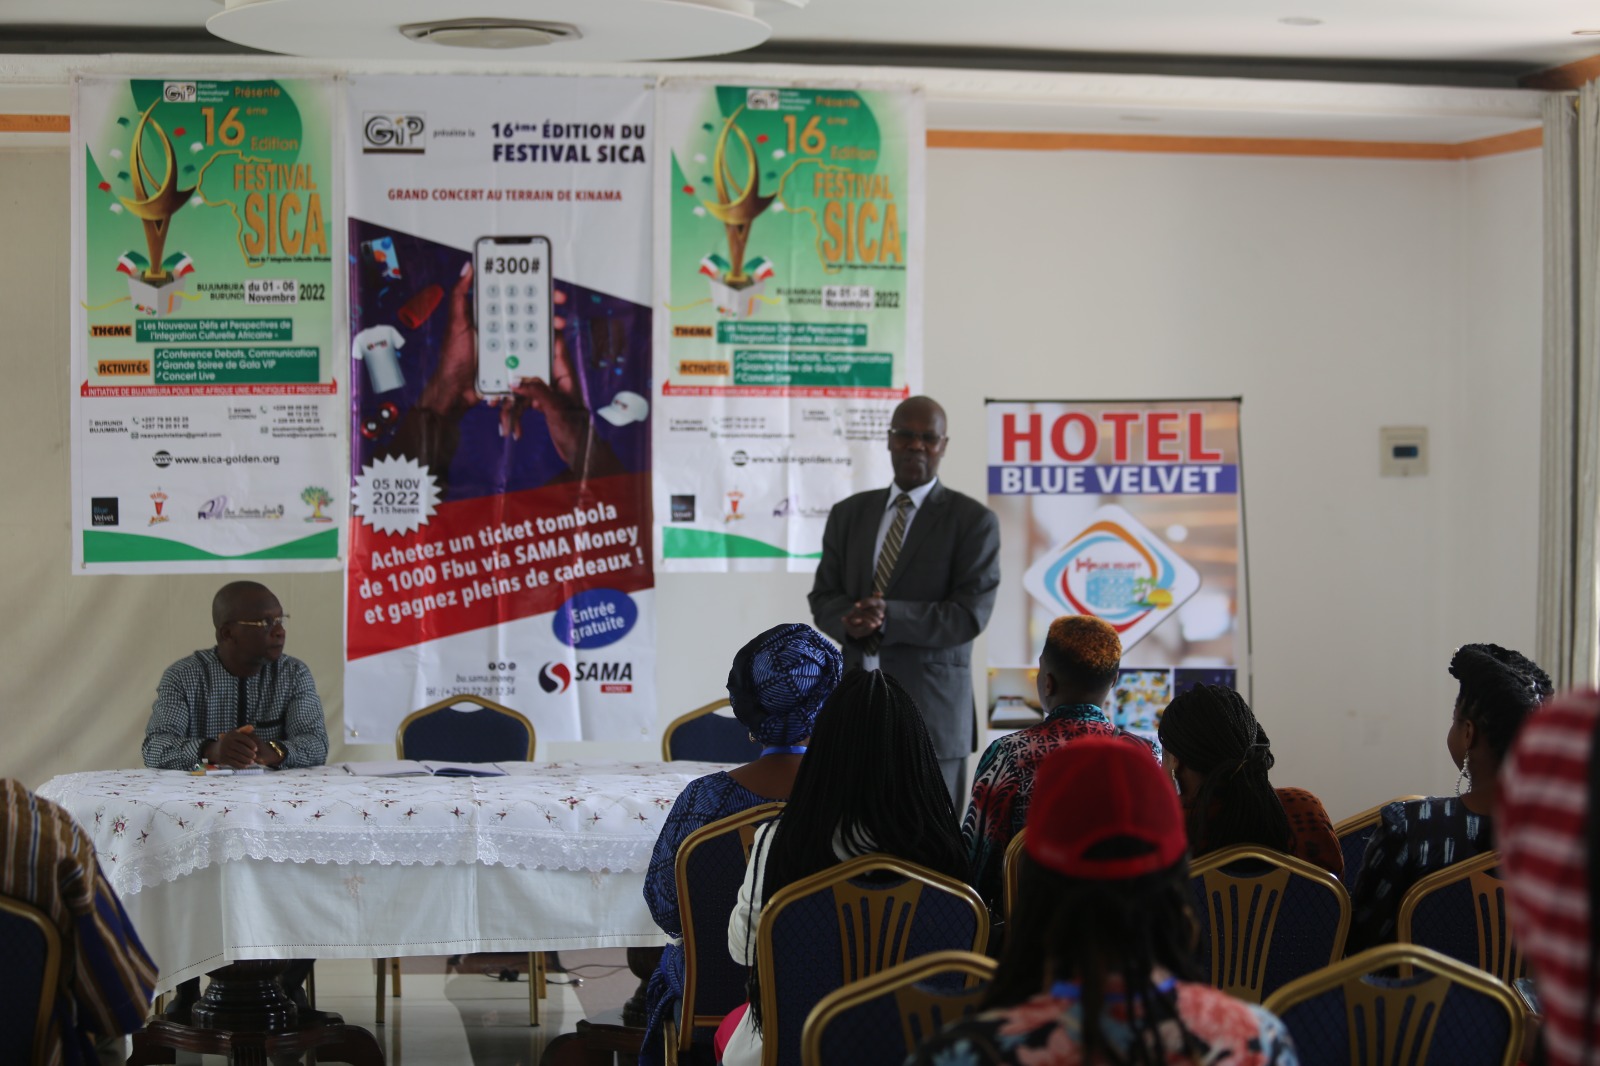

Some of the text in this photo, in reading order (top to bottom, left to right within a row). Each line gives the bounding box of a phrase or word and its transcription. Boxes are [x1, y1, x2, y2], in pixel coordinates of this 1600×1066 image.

[234, 86, 280, 98] Présente
[202, 106, 245, 147] 16
[543, 119, 614, 139] ÉDITION
[621, 124, 646, 139] DU
[783, 114, 827, 155] 16
[493, 144, 646, 163] FESTIVAL SICA
[234, 163, 317, 191] FESTIVAL
[814, 172, 894, 200] FESTIVAL
[388, 189, 623, 202] GRAND CONCERT AU TERRAIN DE KINAMA
[244, 192, 328, 256] SICA
[823, 201, 903, 263] SICA
[485, 257, 540, 275] #300#
[248, 282, 260, 291] du
[262, 282, 273, 291] 01
[283, 282, 295, 291] 06
[300, 284, 325, 301] 2022
[248, 293, 296, 303] Novembre
[92, 326, 132, 337] THEME
[144, 321, 157, 330] Les
[158, 321, 198, 331] Nouveaux
[220, 321, 228, 330] et
[229, 320, 279, 332] Perspectives
[280, 321, 291, 330] de
[199, 331, 236, 340] Culturelle
[237, 331, 273, 340] Africaine
[162, 349, 213, 359] Conference
[248, 348, 317, 359] Communication
[99, 361, 149, 374] ACTIVITÉS
[162, 360, 196, 371] Grande
[225, 360, 237, 370] de
[239, 360, 261, 370] Gala
[262, 359, 277, 369] VIP
[162, 371, 216, 381] Concert Live
[88, 388, 120, 396] INITIATIVE
[121, 388, 130, 396] DE
[131, 387, 171, 396] BUJUMBURA
[1002, 412, 1221, 462] HOTEL
[175, 453, 280, 465] www.sica-golden.org
[372, 478, 420, 490] 05 NOV
[1000, 466, 1222, 493] BLUE VELVET
[372, 491, 420, 506] 2022
[94, 514, 114, 522] Velvet
[370, 501, 618, 571] Achetez un ticket tombola
[359, 525, 639, 600] de 1000 Fbu via SAMA Money
[364, 547, 645, 625] et gagnez pleins de cadeaux !
[571, 601, 616, 624] Entrée
[570, 616, 625, 644] gratuite
[456, 674, 515, 685] bu.sama.money
[575, 662, 633, 682] SAMA
[482, 686, 493, 696] 28
[506, 686, 516, 695] 34
[604, 685, 629, 693] MONEY
